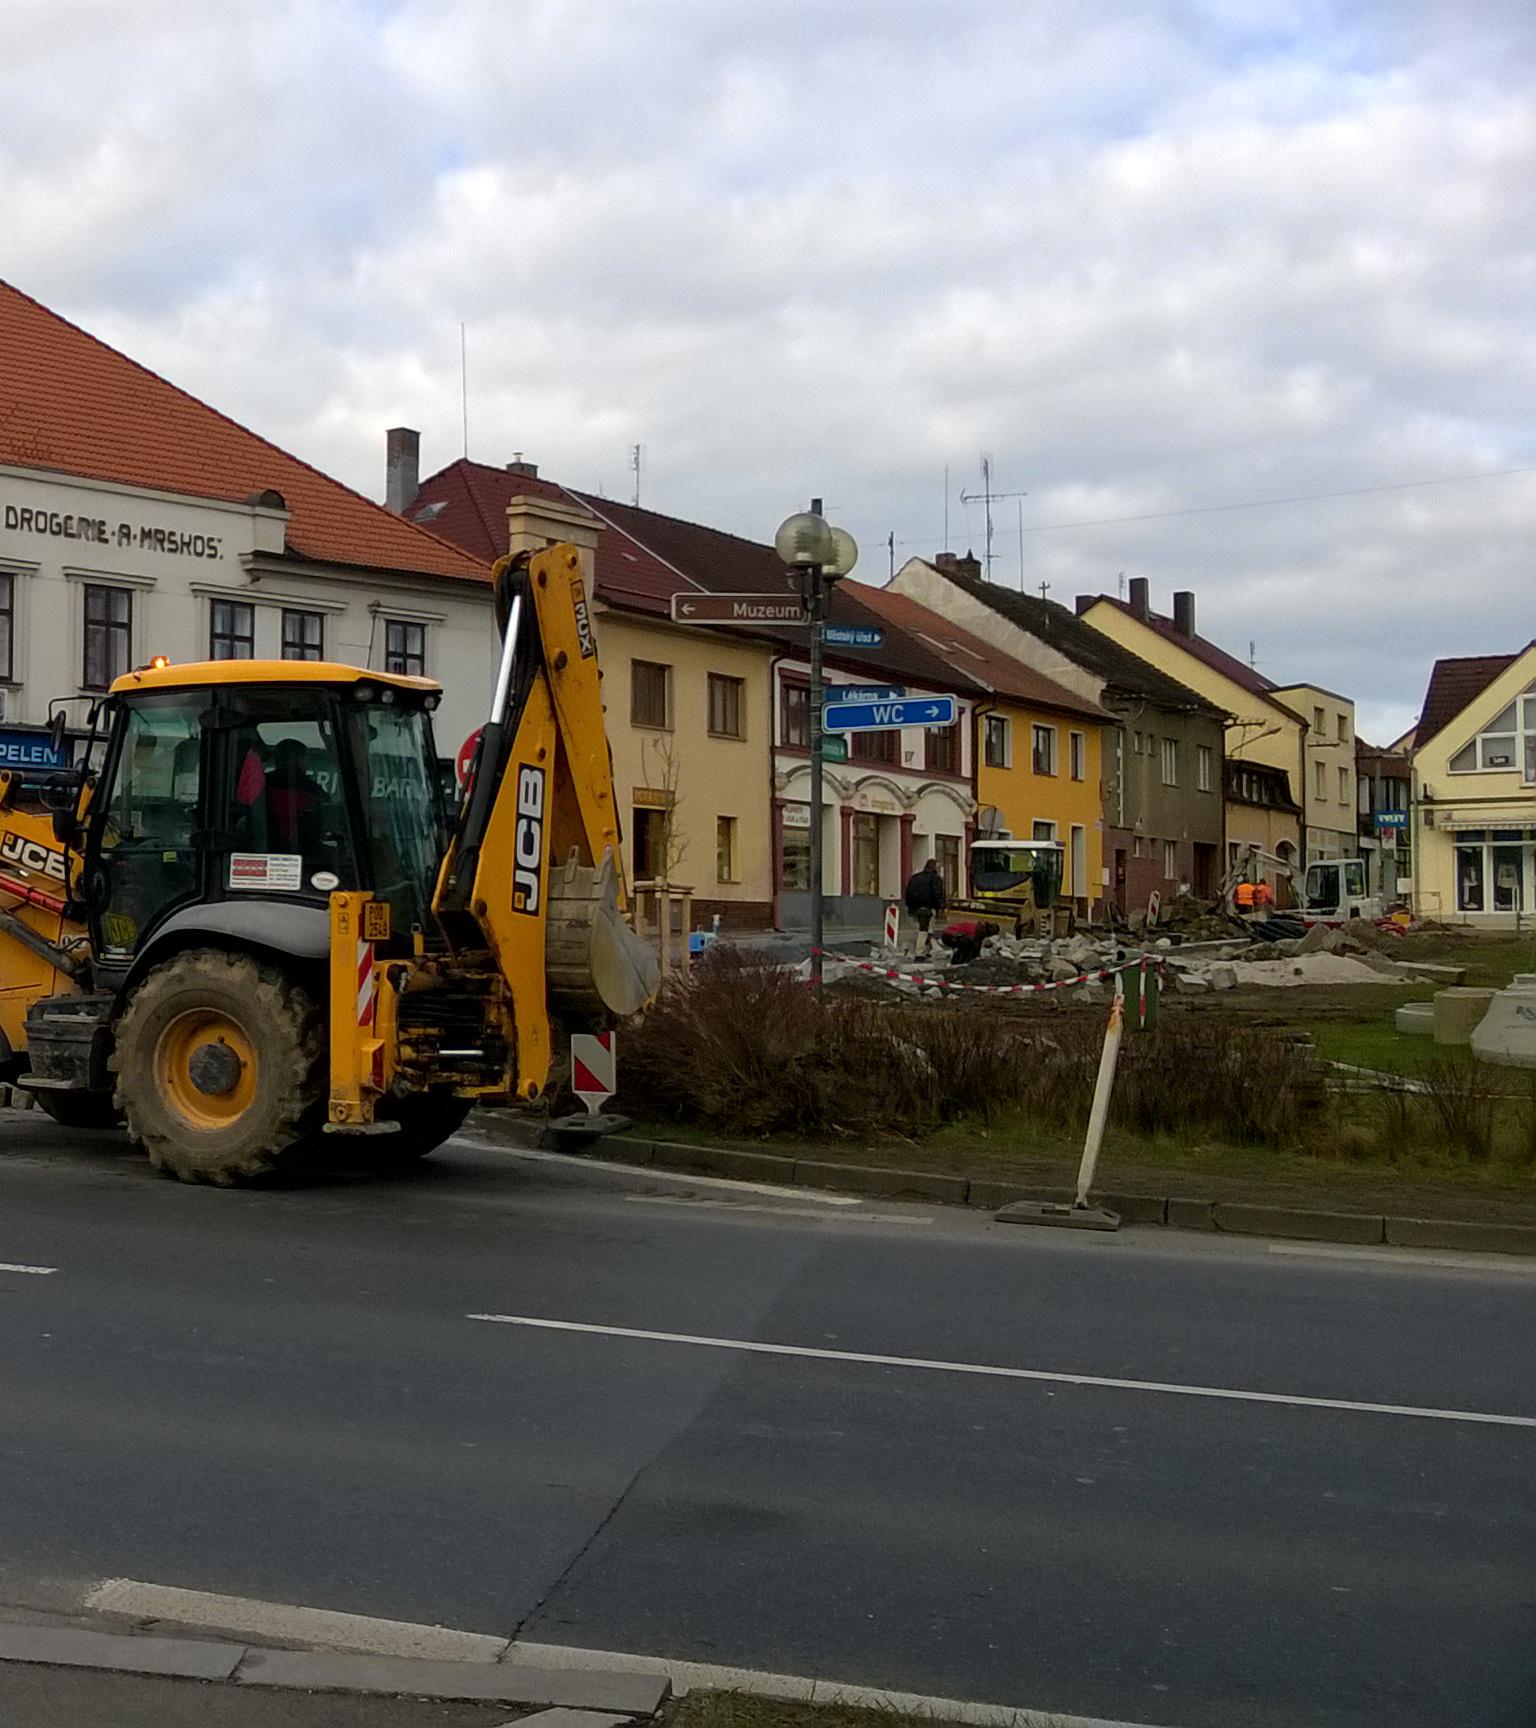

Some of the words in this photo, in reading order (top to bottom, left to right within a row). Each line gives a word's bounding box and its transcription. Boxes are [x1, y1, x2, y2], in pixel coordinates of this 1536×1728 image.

[5, 505, 109, 544] DROGERIE
[575, 602, 593, 655] 3CX
[733, 602, 801, 618] Muzeum
[872, 705, 905, 724] WC
[2, 838, 66, 880] JCB
[514, 767, 544, 912] JCB
